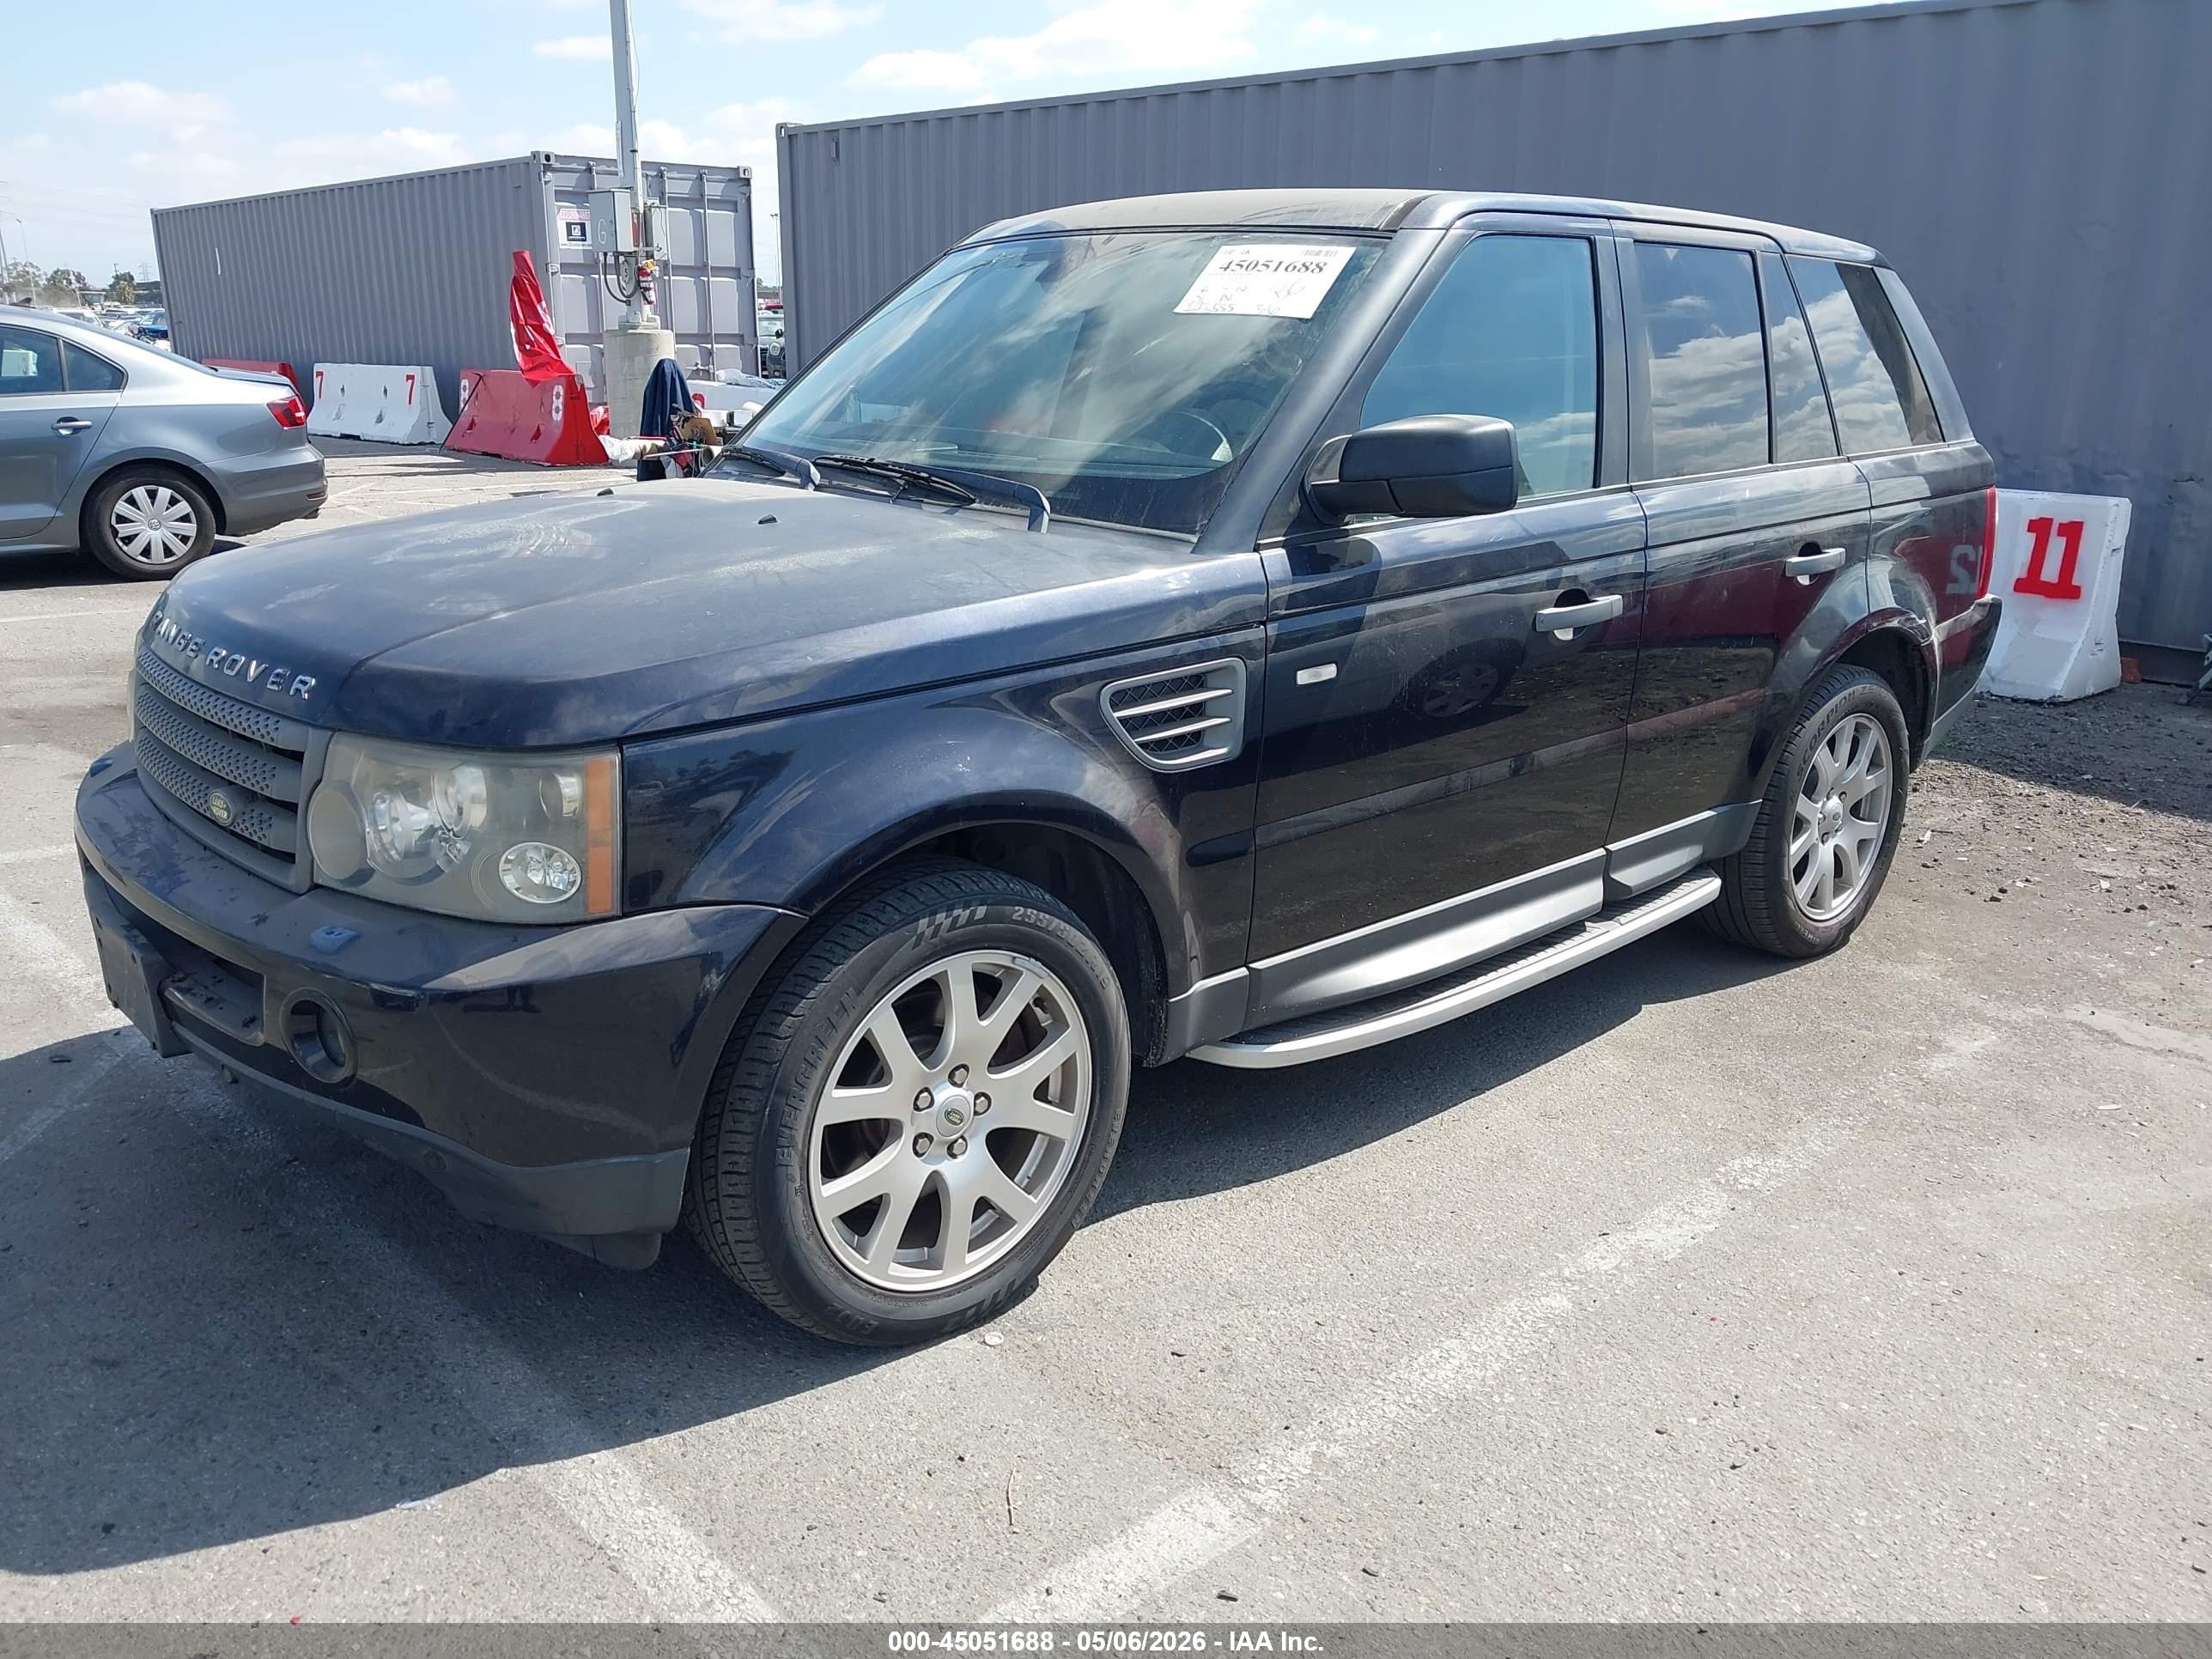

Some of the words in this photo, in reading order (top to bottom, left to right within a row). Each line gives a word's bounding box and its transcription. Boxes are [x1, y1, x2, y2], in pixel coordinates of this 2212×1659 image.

[1218, 259, 1328, 275] 45051688
[315, 370, 325, 399] 7
[405, 374, 416, 406] 7
[459, 378, 470, 415] 8
[552, 384, 564, 422] 8
[2012, 516, 2086, 600] 11
[149, 610, 207, 659] RANGE
[205, 645, 318, 701] ROVER
[775, 985, 859, 1168] EVERGREEN
